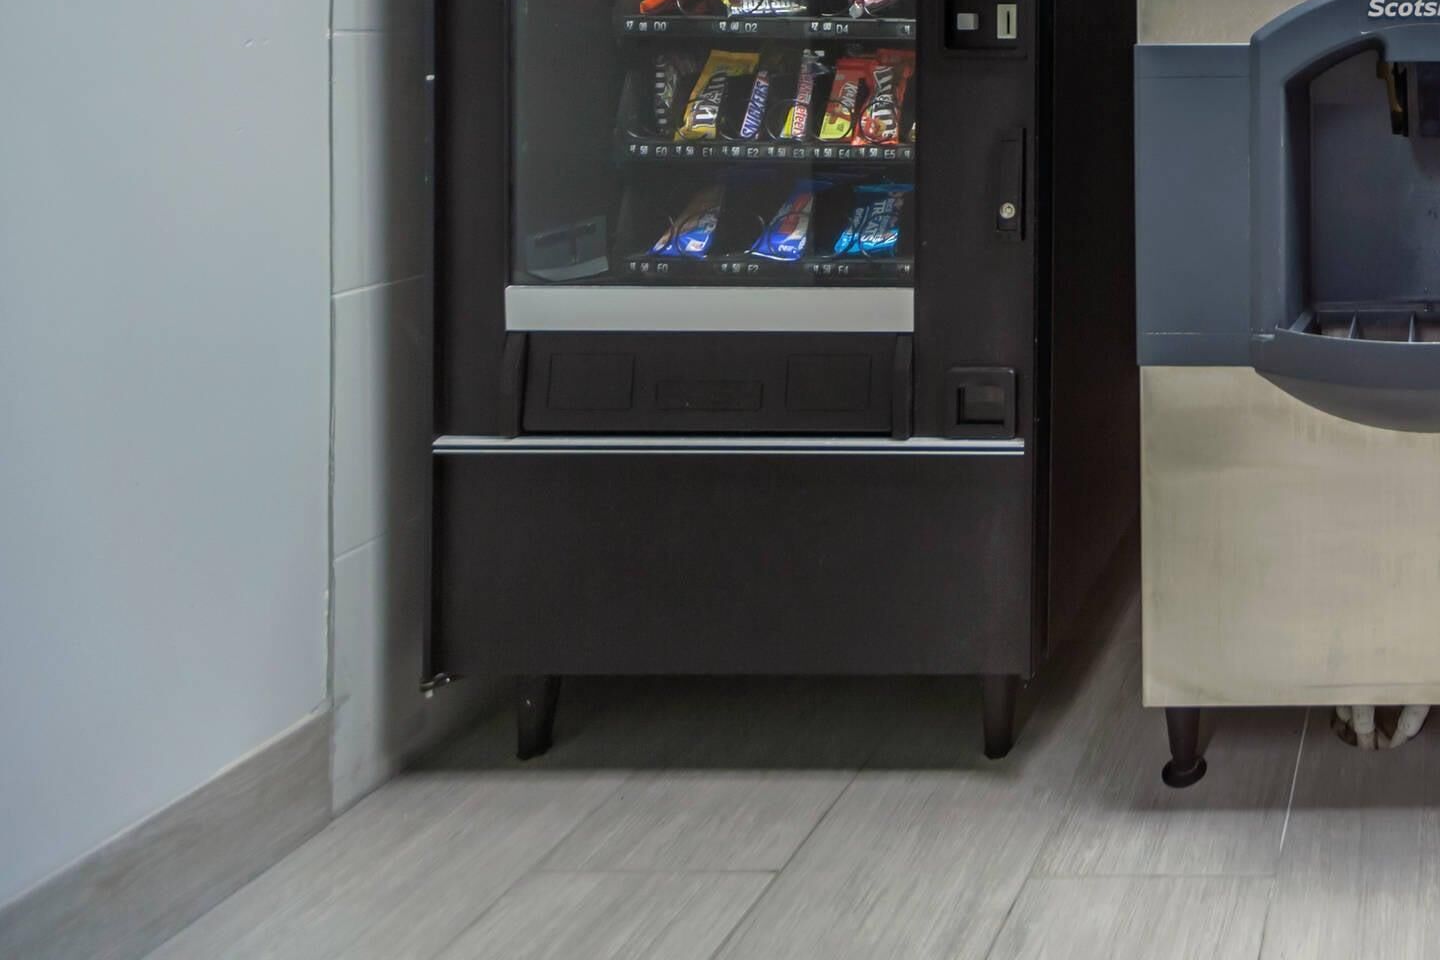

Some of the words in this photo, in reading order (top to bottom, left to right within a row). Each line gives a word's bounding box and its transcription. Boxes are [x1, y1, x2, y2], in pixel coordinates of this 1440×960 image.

[836, 24, 849, 34] D4
[741, 80, 769, 138] SNICKERS
[702, 148, 713, 156] E1
[747, 148, 759, 157] E2
[838, 149, 851, 158] E4
[884, 150, 896, 159] E5
